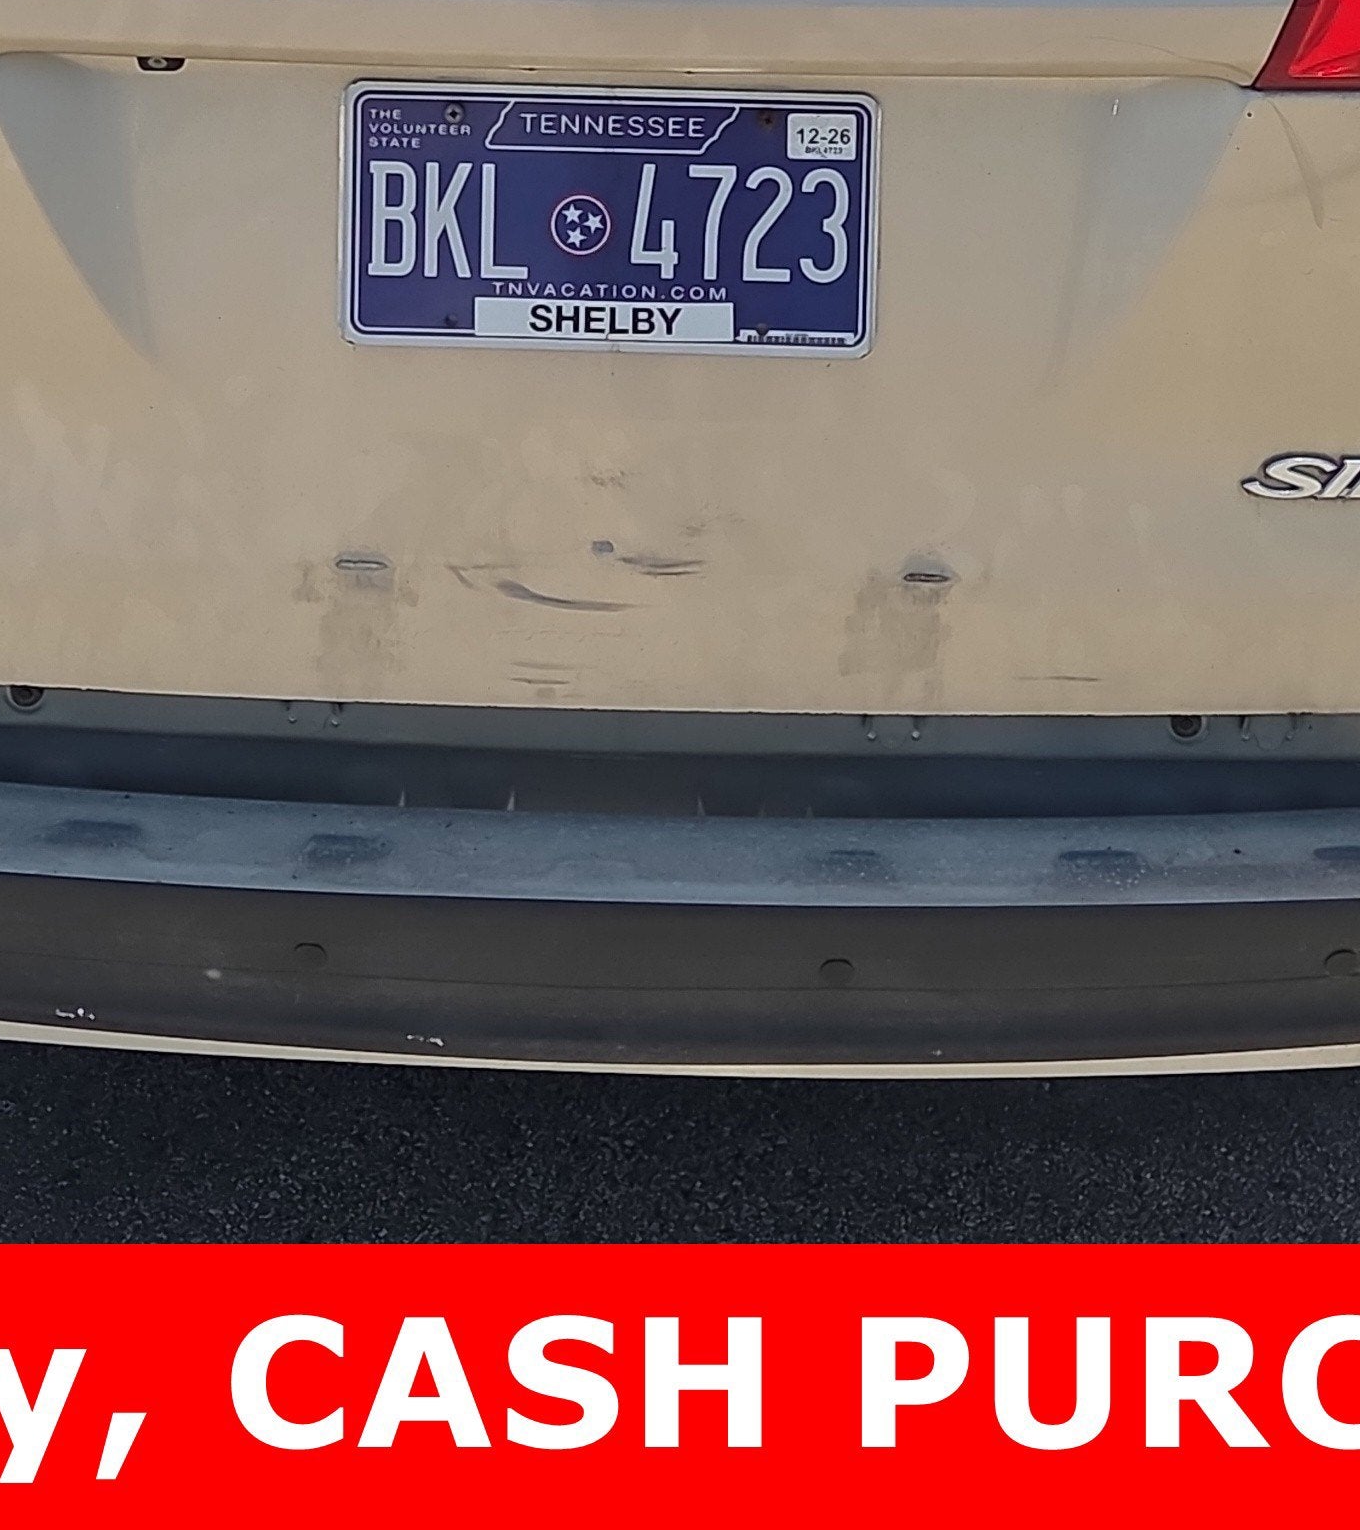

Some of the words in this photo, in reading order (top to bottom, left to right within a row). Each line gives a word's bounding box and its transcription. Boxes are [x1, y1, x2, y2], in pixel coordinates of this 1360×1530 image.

[369, 108, 402, 120] THE
[368, 122, 472, 137] VOLUNTEER
[519, 113, 706, 138] TENNESSEE
[368, 136, 422, 149] STATE
[796, 128, 852, 145] 12-26
[367, 160, 530, 279] BKL
[630, 162, 852, 285] 4723
[492, 281, 728, 301] TNVACATION.COM
[529, 303, 683, 336] SHELBY
